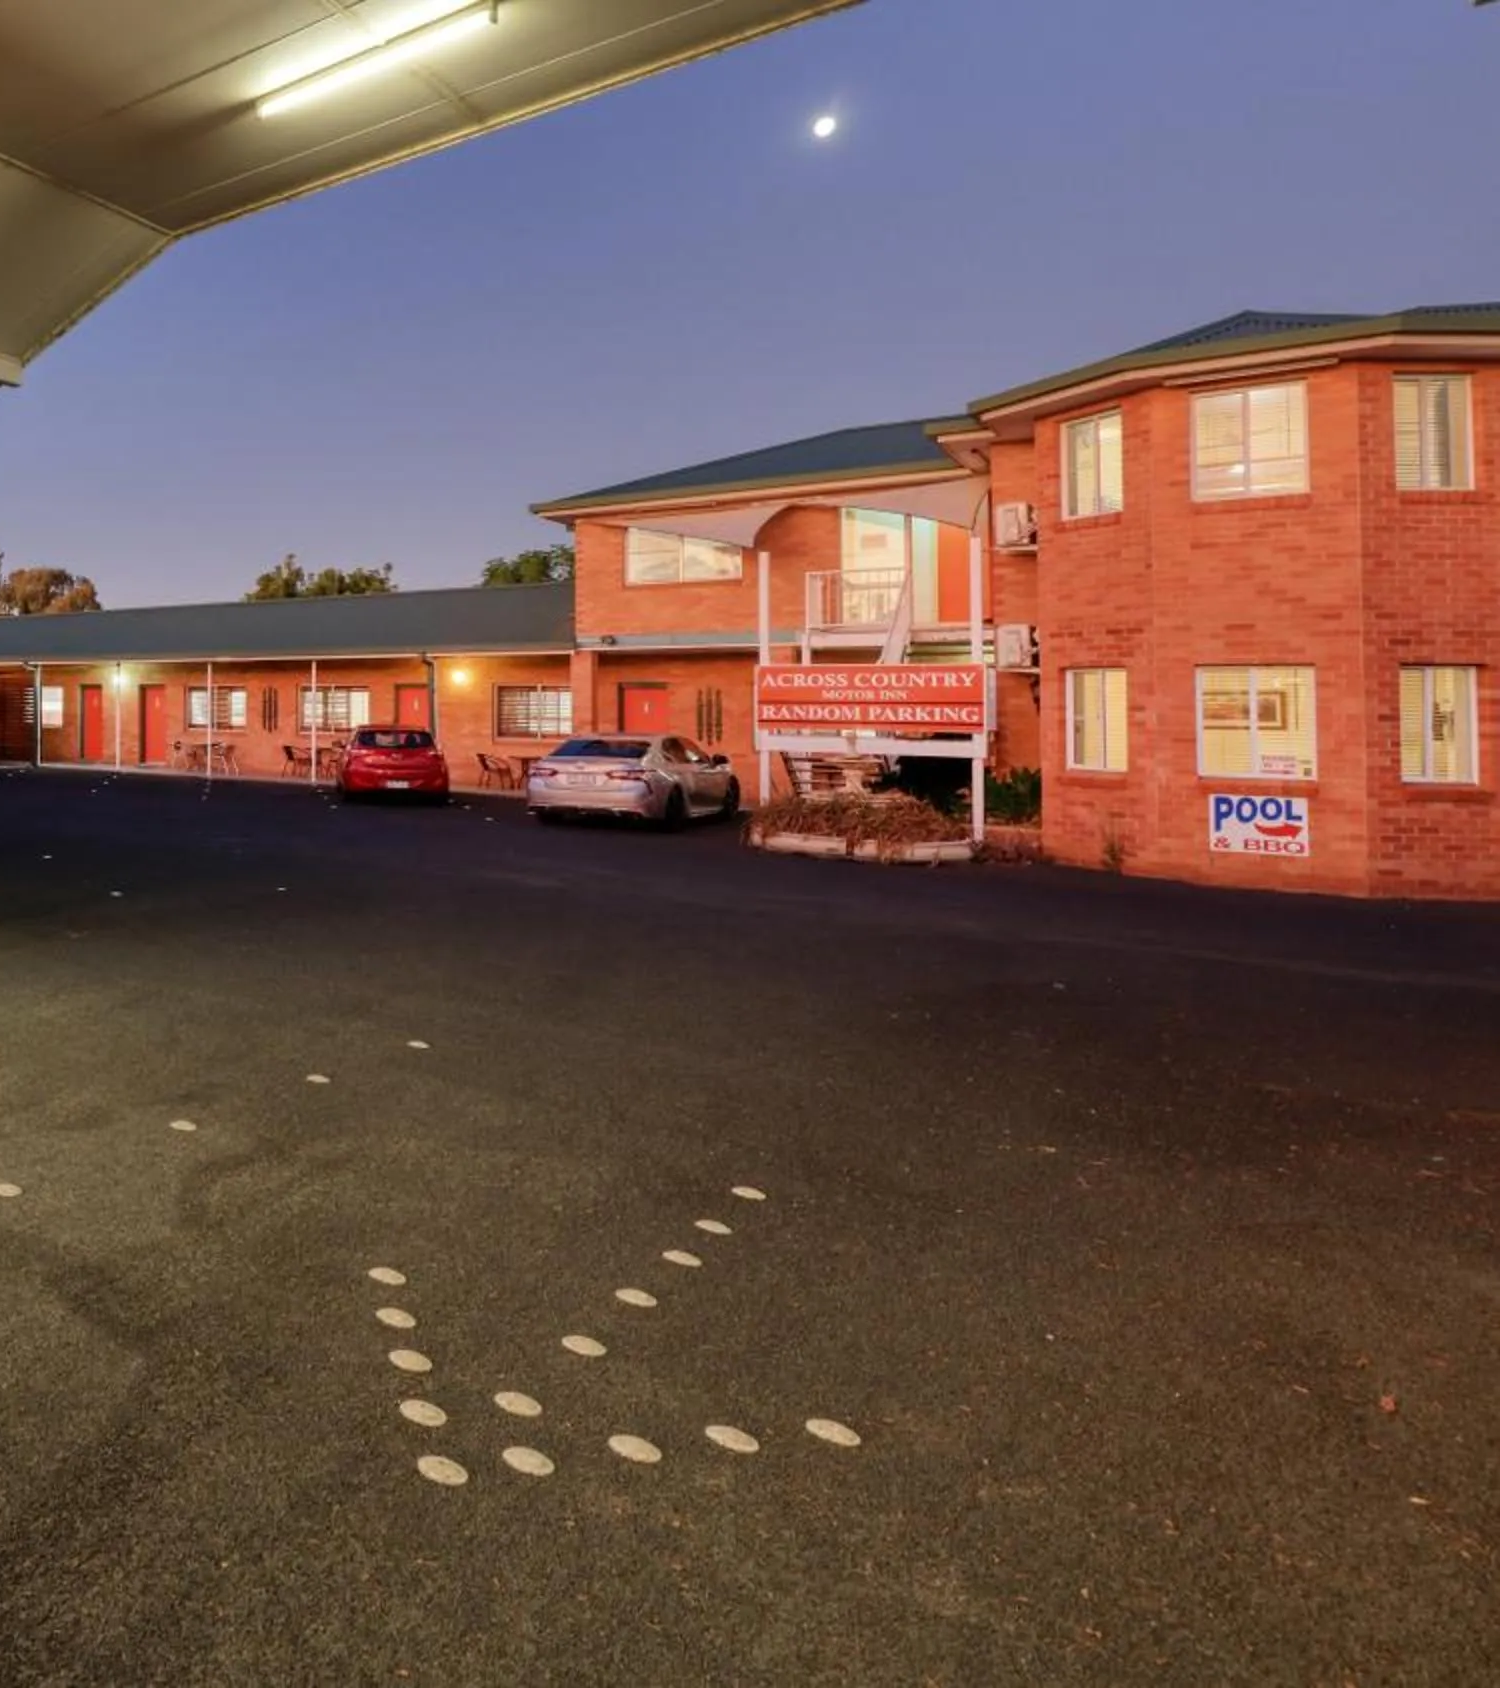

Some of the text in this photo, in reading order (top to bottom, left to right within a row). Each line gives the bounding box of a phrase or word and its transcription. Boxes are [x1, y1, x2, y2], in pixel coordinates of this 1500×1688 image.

[761, 671, 977, 688] ACROSS COUNTRY
[820, 689, 908, 701] MOTOR INN
[762, 704, 980, 723] RANDOM PARKING
[1213, 796, 1303, 832] POOL
[1213, 836, 1305, 854] & BBQ
